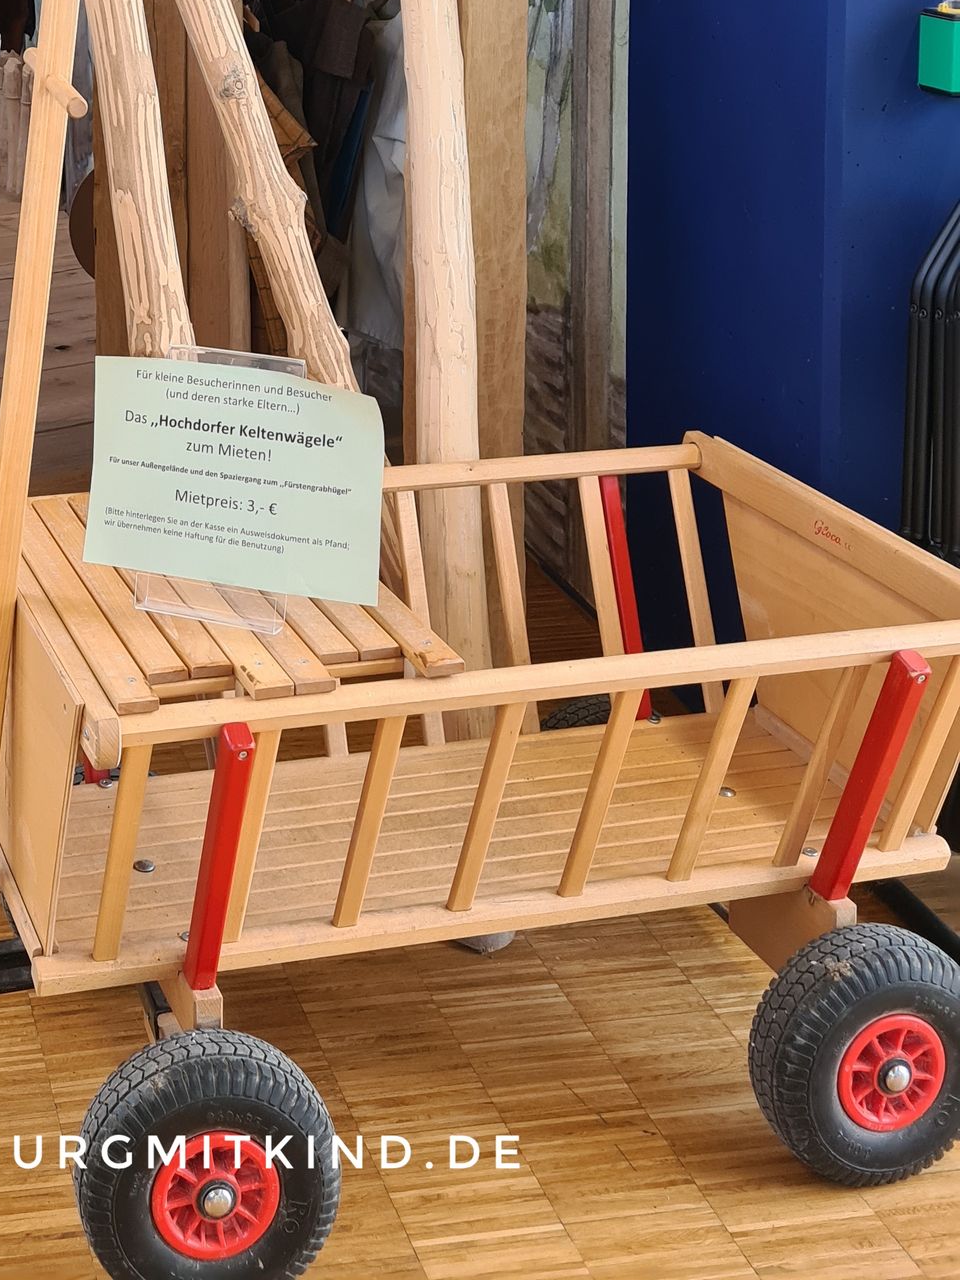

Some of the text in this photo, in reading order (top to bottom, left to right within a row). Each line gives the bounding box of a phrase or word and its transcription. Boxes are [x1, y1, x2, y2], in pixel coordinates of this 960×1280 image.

[136, 369, 332, 402] Für kleine Besucherinnen und Besucher
[166, 388, 300, 415] (und deren starke Eltern...)
[125, 410, 148, 424] Das
[186, 441, 272, 462] zum Mieten!
[121, 459, 139, 467] unser
[140, 461, 189, 474] Außengelände
[190, 468, 204, 476] und
[205, 470, 218, 478] den
[219, 472, 262, 486] Spaziergang
[262, 479, 278, 487] zum
[175, 489, 278, 516] Mietpreis: 3,- €
[104, 519, 285, 554] wir übernehmen keine Haftung für die Benutzung)
[105, 506, 350, 551] (Bitte hinterlegen Sie an der Kasse ein Ausweisdokument als Pfand;
